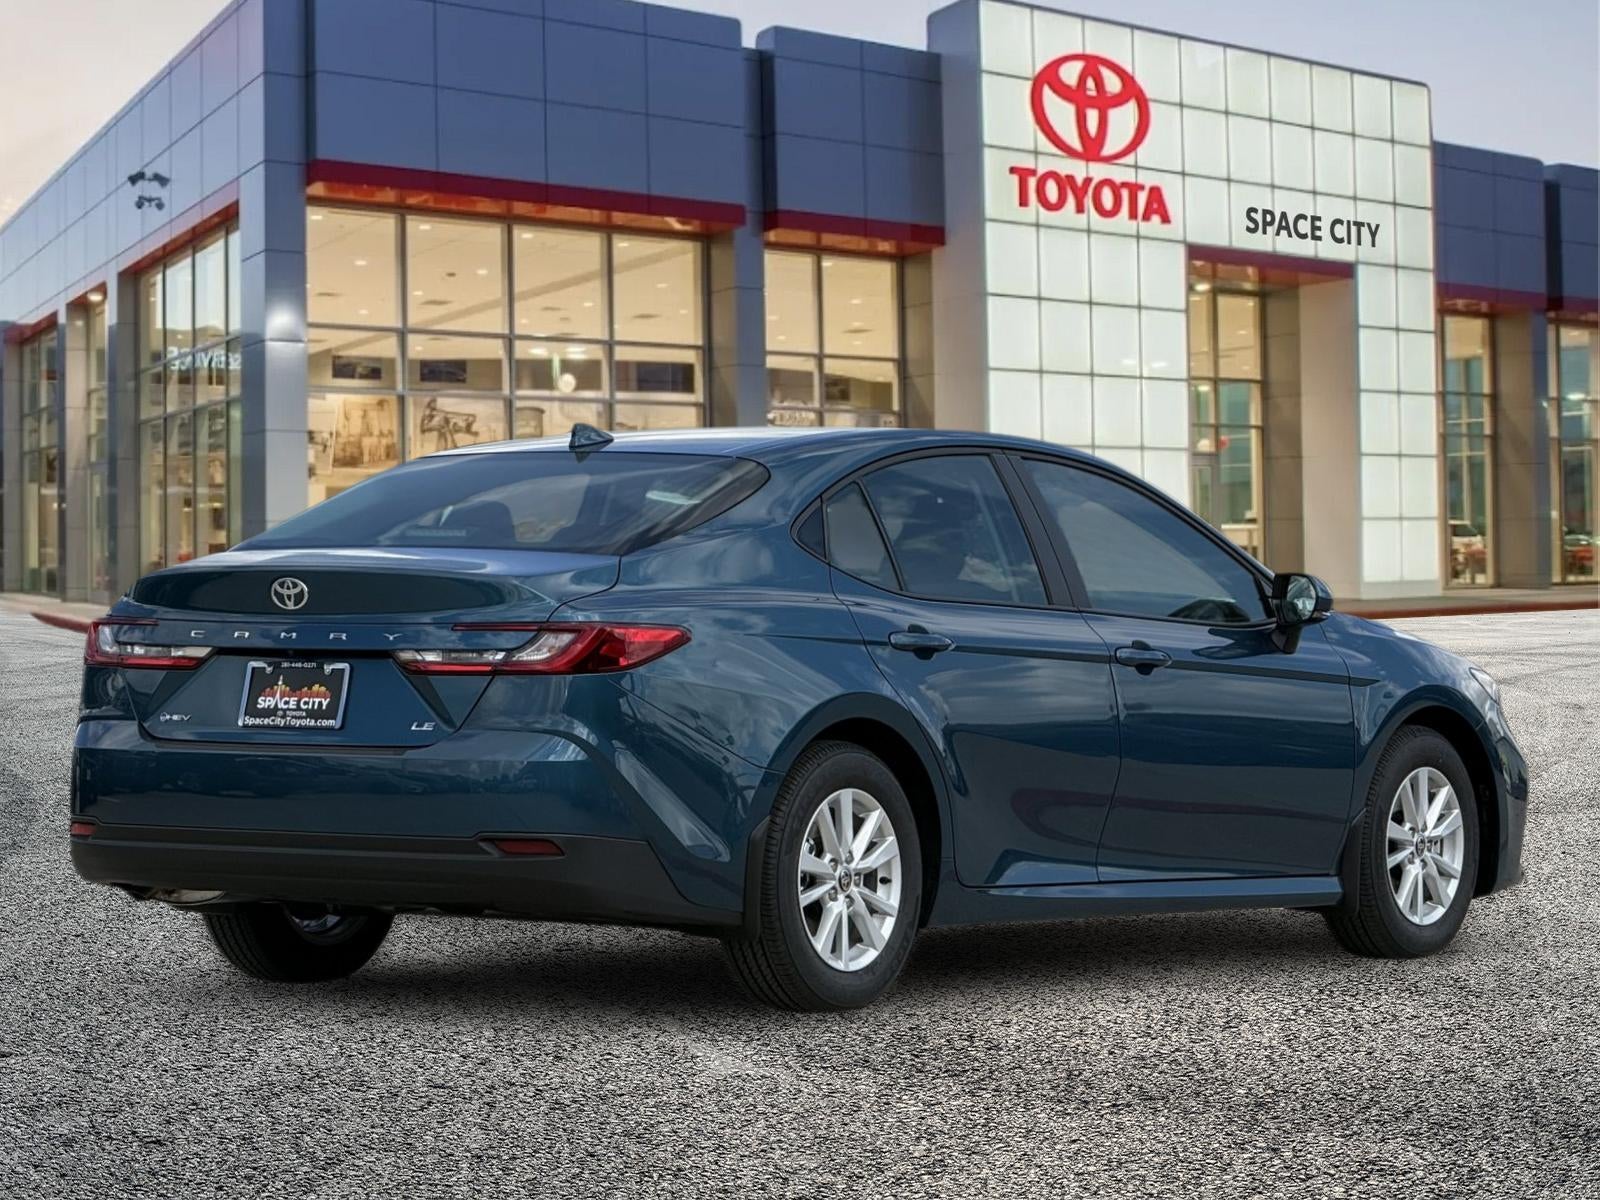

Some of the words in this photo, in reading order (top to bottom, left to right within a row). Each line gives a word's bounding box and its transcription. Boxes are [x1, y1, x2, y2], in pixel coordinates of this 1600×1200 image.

[1009, 166, 1171, 224] TOYOTA
[1245, 206, 1322, 241] SPACE
[1329, 217, 1380, 248] CITY
[190, 630, 403, 641] CAMRY
[256, 695, 297, 710] SPACE
[300, 697, 330, 710] CITY
[244, 715, 336, 727] SpaceCityToyota.com
[410, 721, 436, 731] LE
